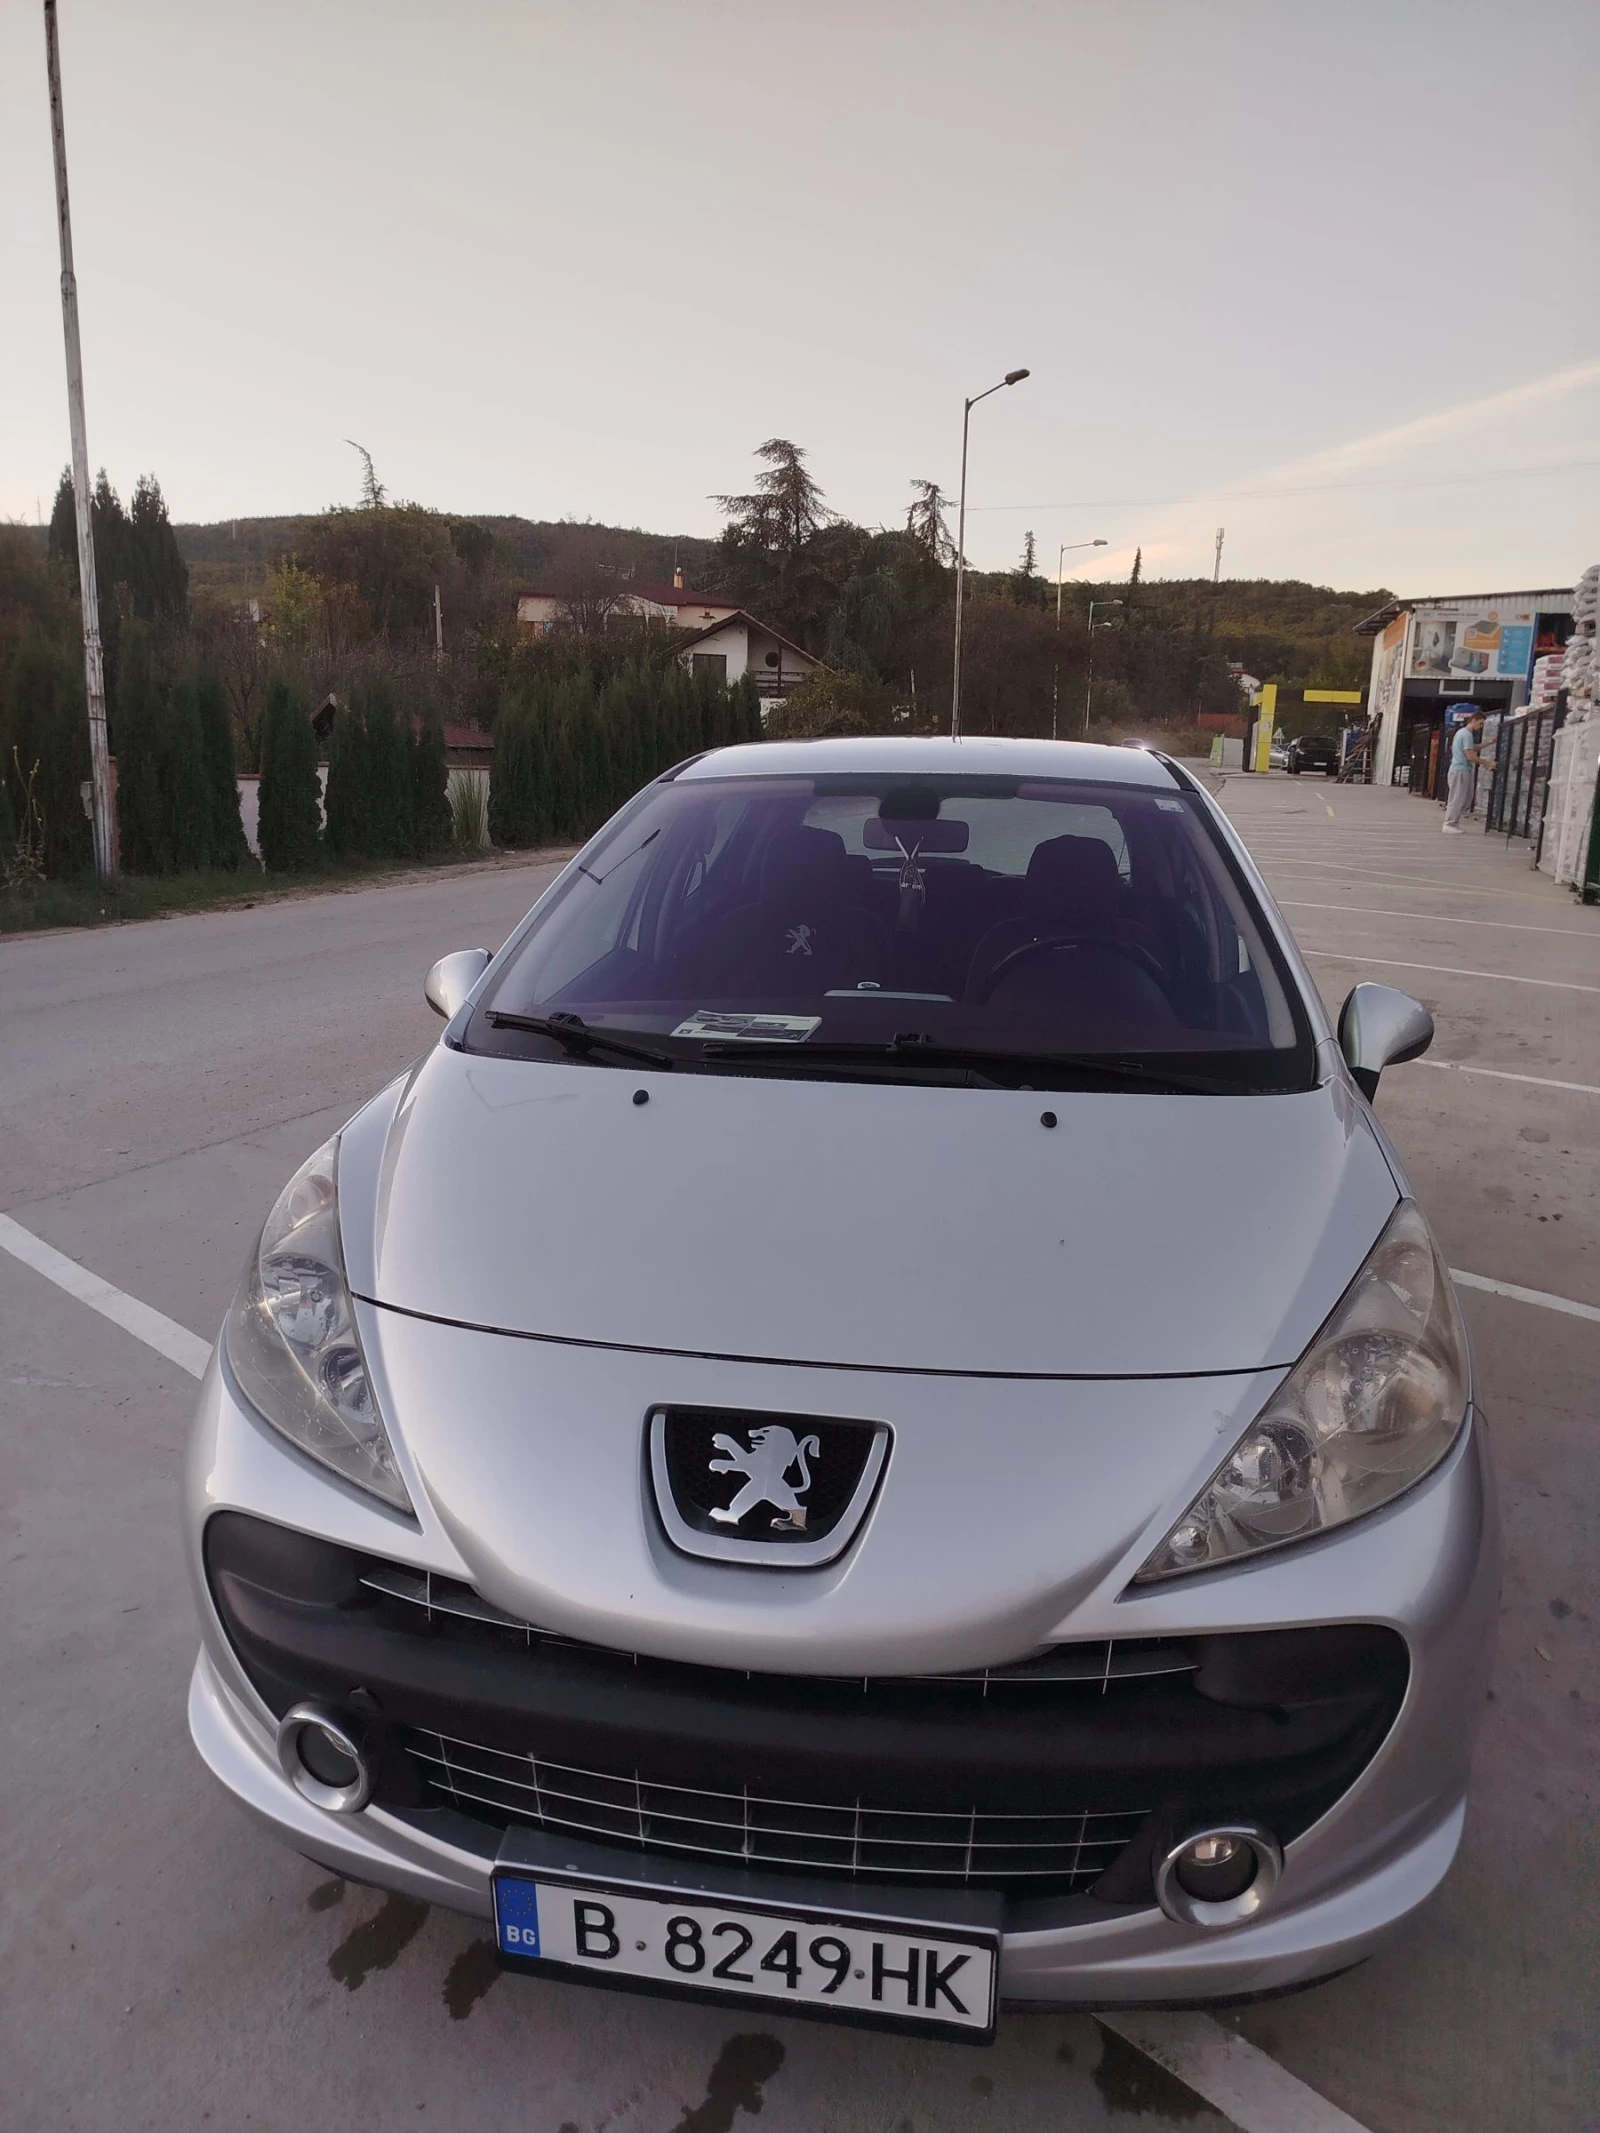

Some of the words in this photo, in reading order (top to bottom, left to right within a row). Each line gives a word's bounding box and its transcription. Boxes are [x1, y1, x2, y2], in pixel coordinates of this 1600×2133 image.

[506, 1925, 536, 1946] BG
[573, 1899, 620, 1960] B
[664, 1916, 852, 1994] 8249
[871, 1942, 972, 2014] HK
